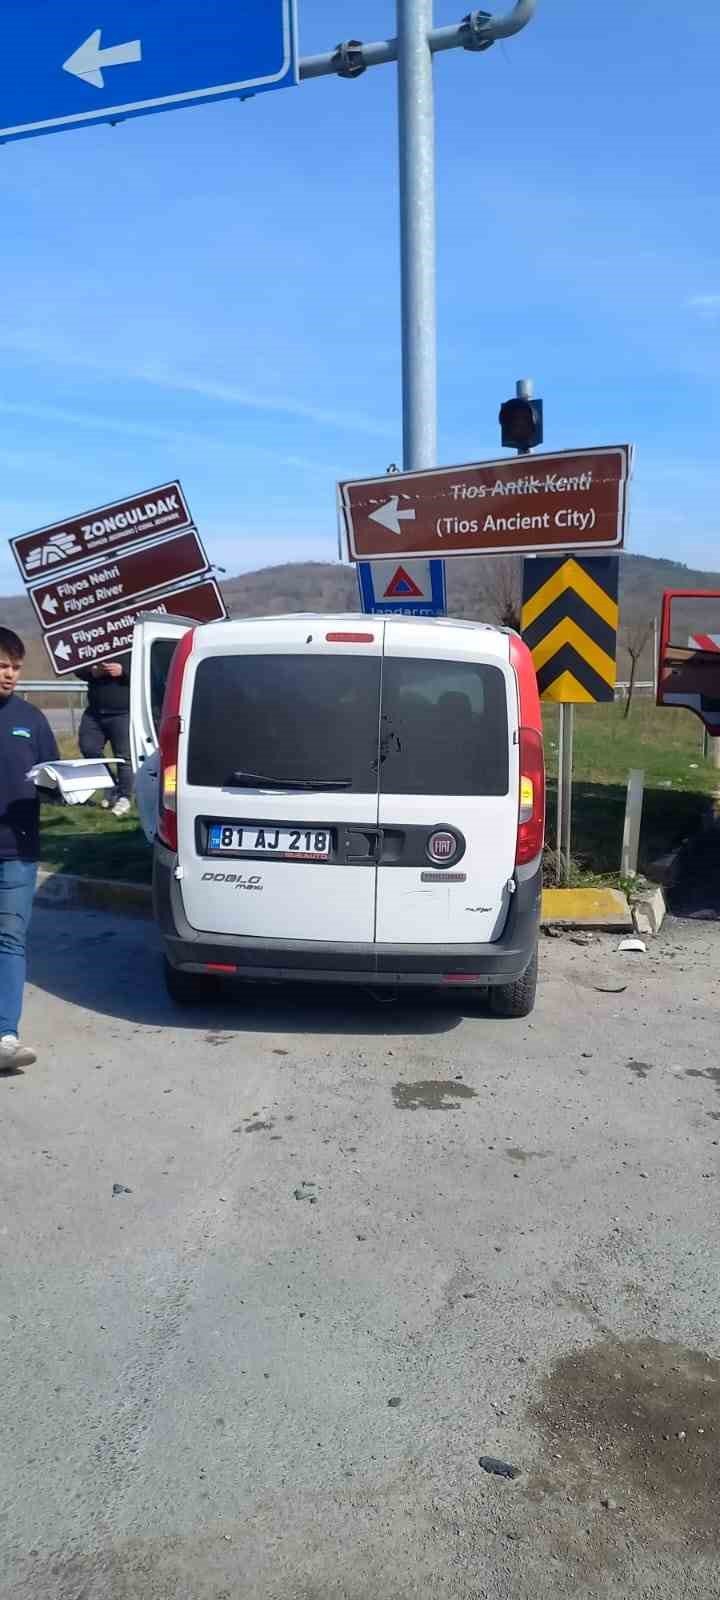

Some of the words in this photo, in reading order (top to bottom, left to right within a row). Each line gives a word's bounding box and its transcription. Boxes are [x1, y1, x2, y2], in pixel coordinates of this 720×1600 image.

[450, 482, 487, 501] Tios
[491, 475, 541, 496] Antik
[544, 471, 592, 492] Kenti
[81, 494, 180, 541] ZONGULDAK
[436, 517, 478, 538] (Tios
[483, 512, 550, 532] Ancient
[555, 508, 596, 531] City)
[57, 579, 89, 597] Filyos
[88, 565, 121, 586] Nehri
[64, 595, 95, 613] Filyos
[96, 583, 124, 601] River
[72, 627, 105, 644] Filyos
[107, 615, 137, 632] Antik
[78, 642, 110, 659] Filyos
[221, 828, 244, 847] 81
[254, 829, 280, 849] AJ
[288, 831, 327, 851] 218
